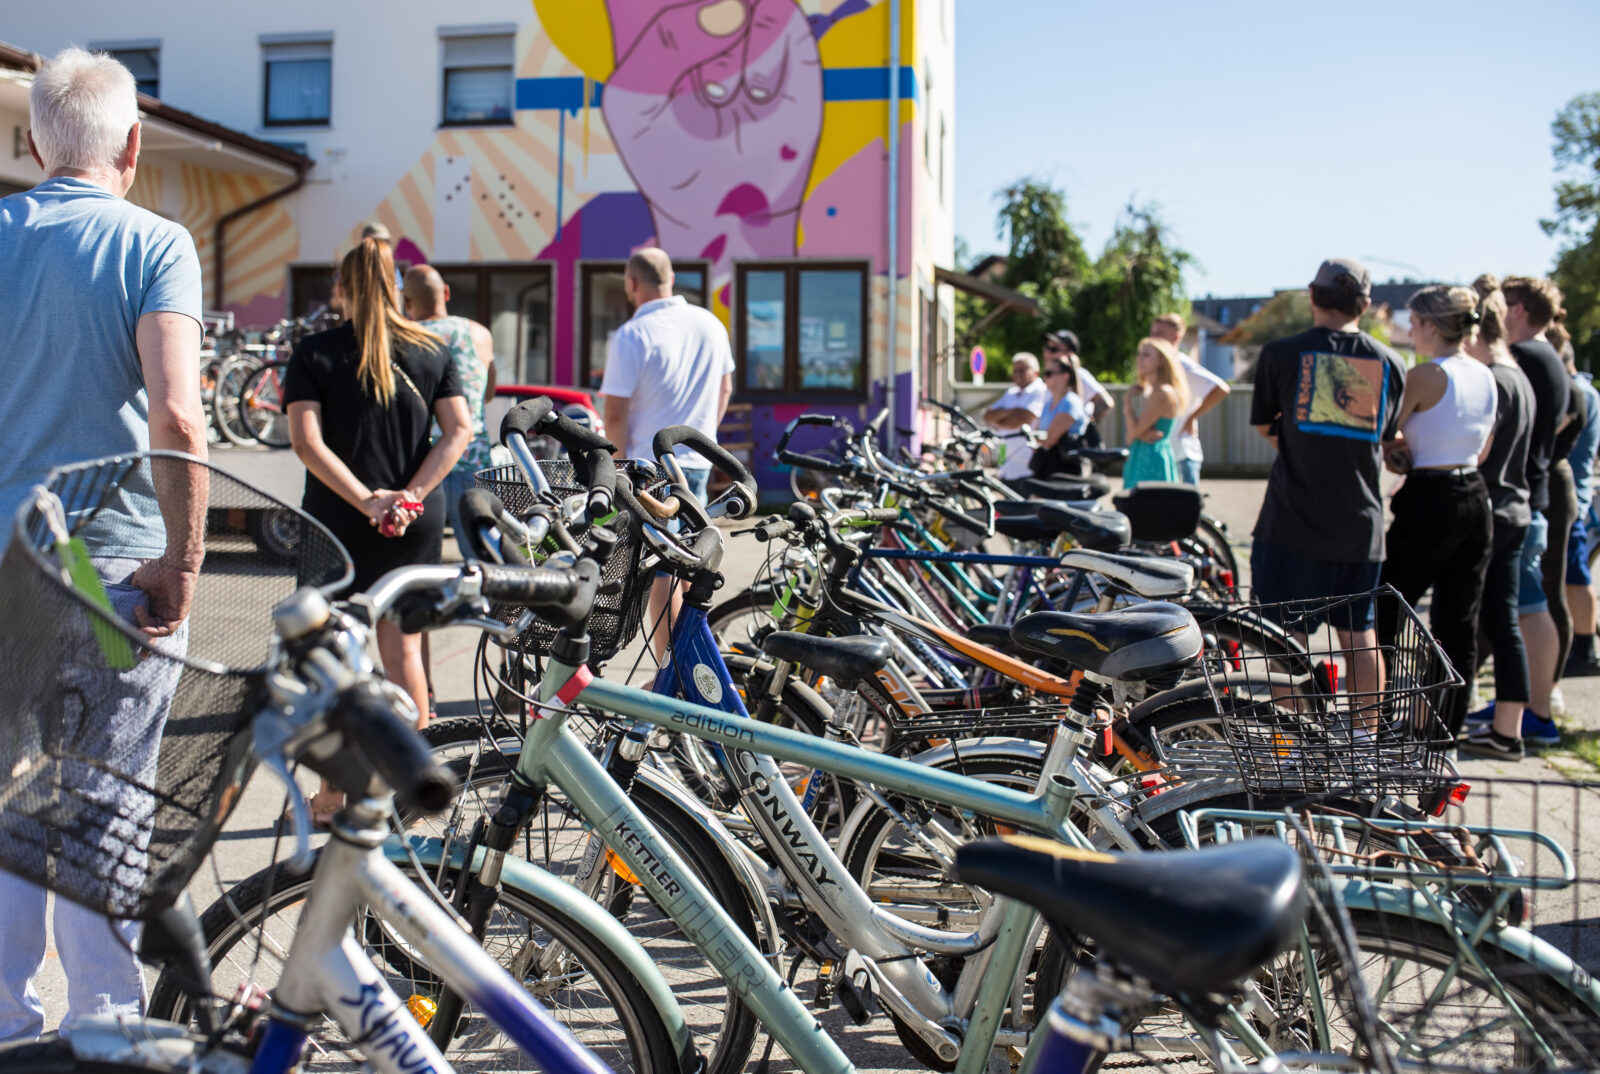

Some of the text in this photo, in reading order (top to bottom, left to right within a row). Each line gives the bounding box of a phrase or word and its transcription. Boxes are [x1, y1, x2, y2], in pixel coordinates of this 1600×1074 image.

[670, 710, 756, 743] adition
[735, 748, 837, 886] CONWAY
[614, 820, 682, 898] KETTLER
